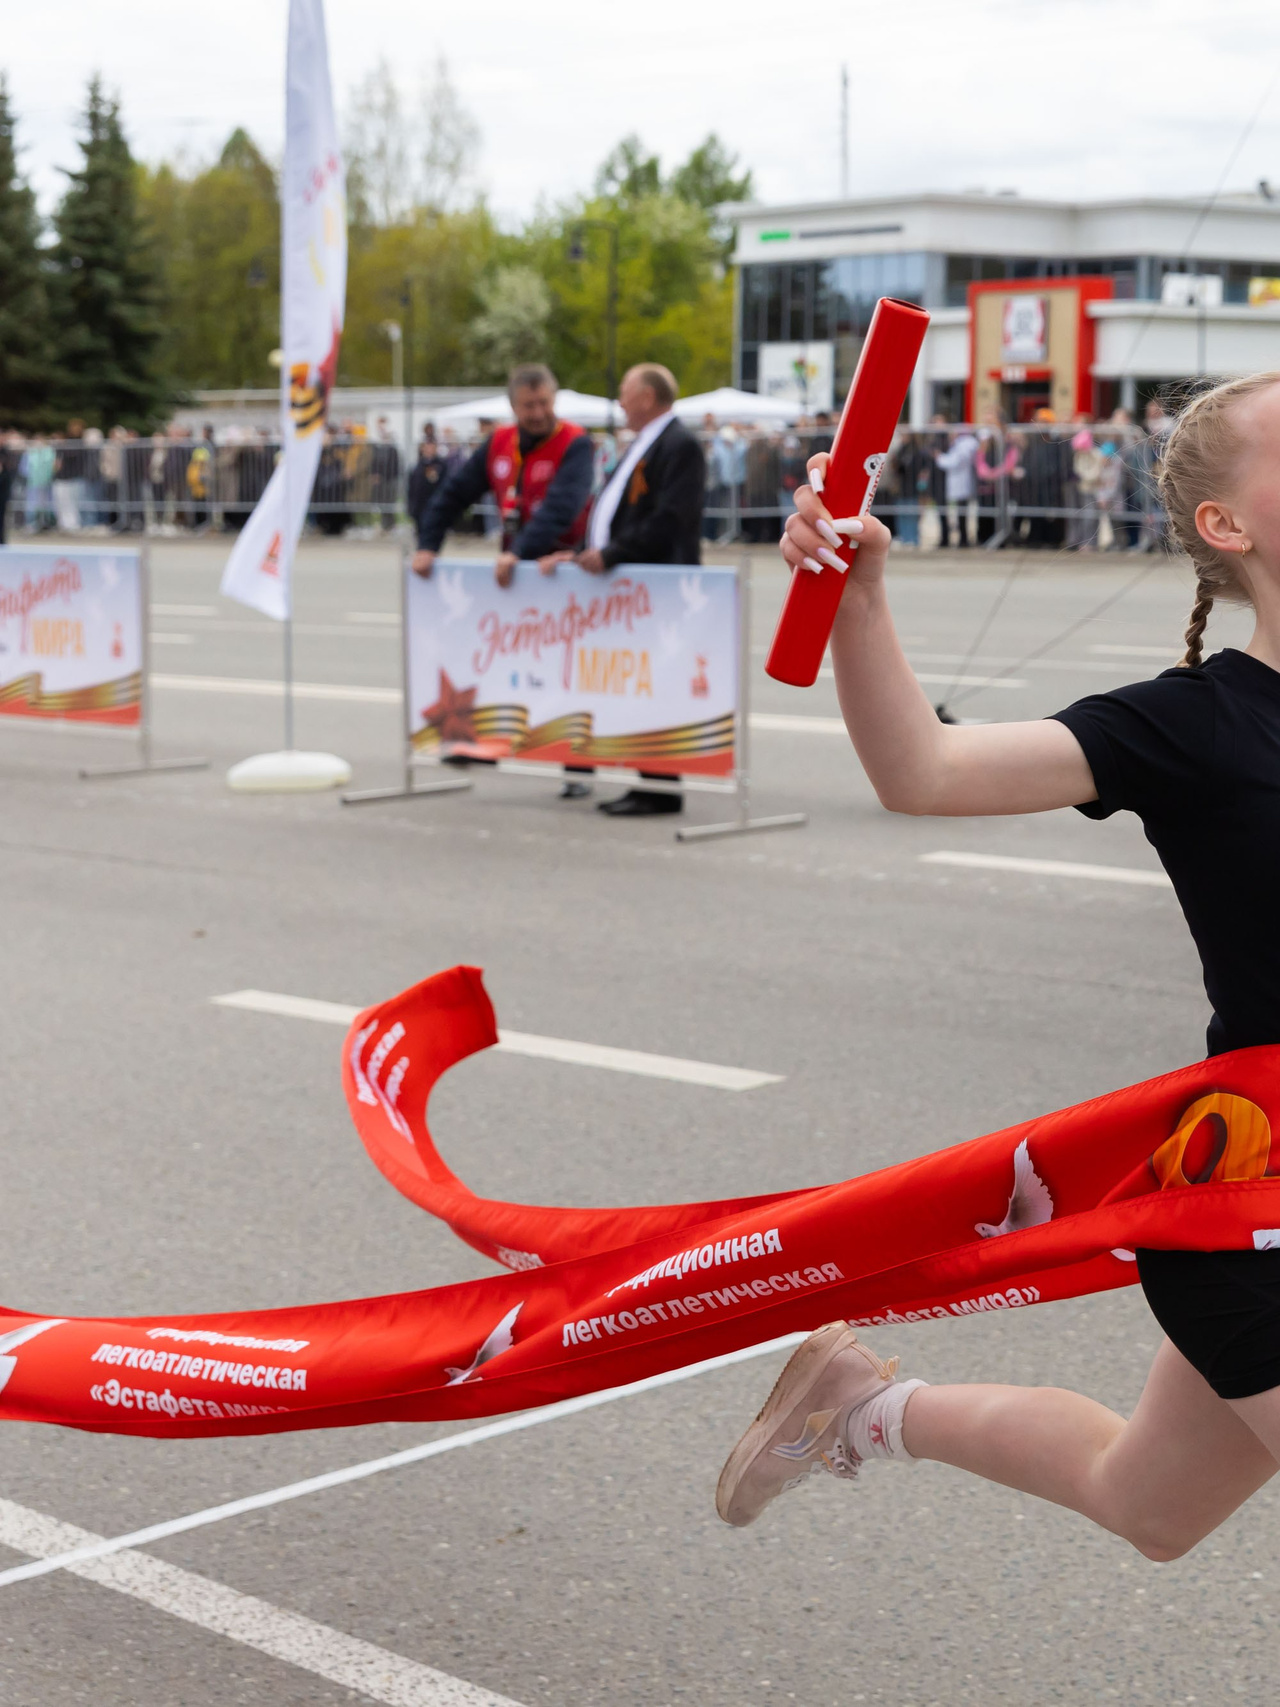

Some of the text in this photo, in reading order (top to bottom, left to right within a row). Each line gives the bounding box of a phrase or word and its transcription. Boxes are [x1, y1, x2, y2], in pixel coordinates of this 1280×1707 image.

[473, 577, 653, 690] Эстафета
[577, 646, 654, 698] МИРА
[561, 1261, 845, 1348] легкоатлетическая
[90, 1342, 308, 1391] легкоатлетическая
[89, 1377, 225, 1419] «Эстафета
